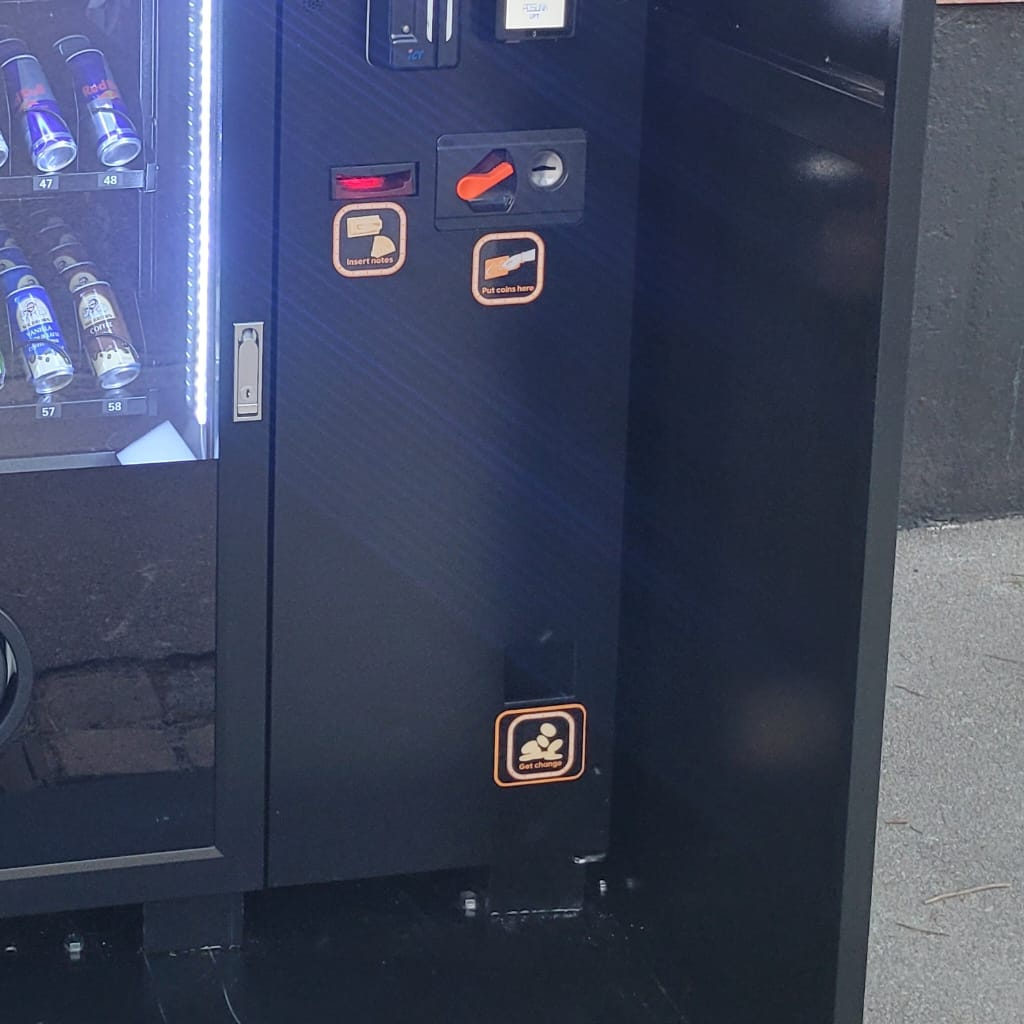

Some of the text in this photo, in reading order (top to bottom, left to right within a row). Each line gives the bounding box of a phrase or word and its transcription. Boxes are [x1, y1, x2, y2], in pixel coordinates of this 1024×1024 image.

[39, 178, 54, 188] 47
[103, 175, 118, 185] 48
[346, 256, 394, 266] Insert notes
[482, 284, 534, 294] Put coins here
[42, 407, 56, 417] 57
[108, 402, 122, 412] 58
[518, 760, 562, 770] Get change
